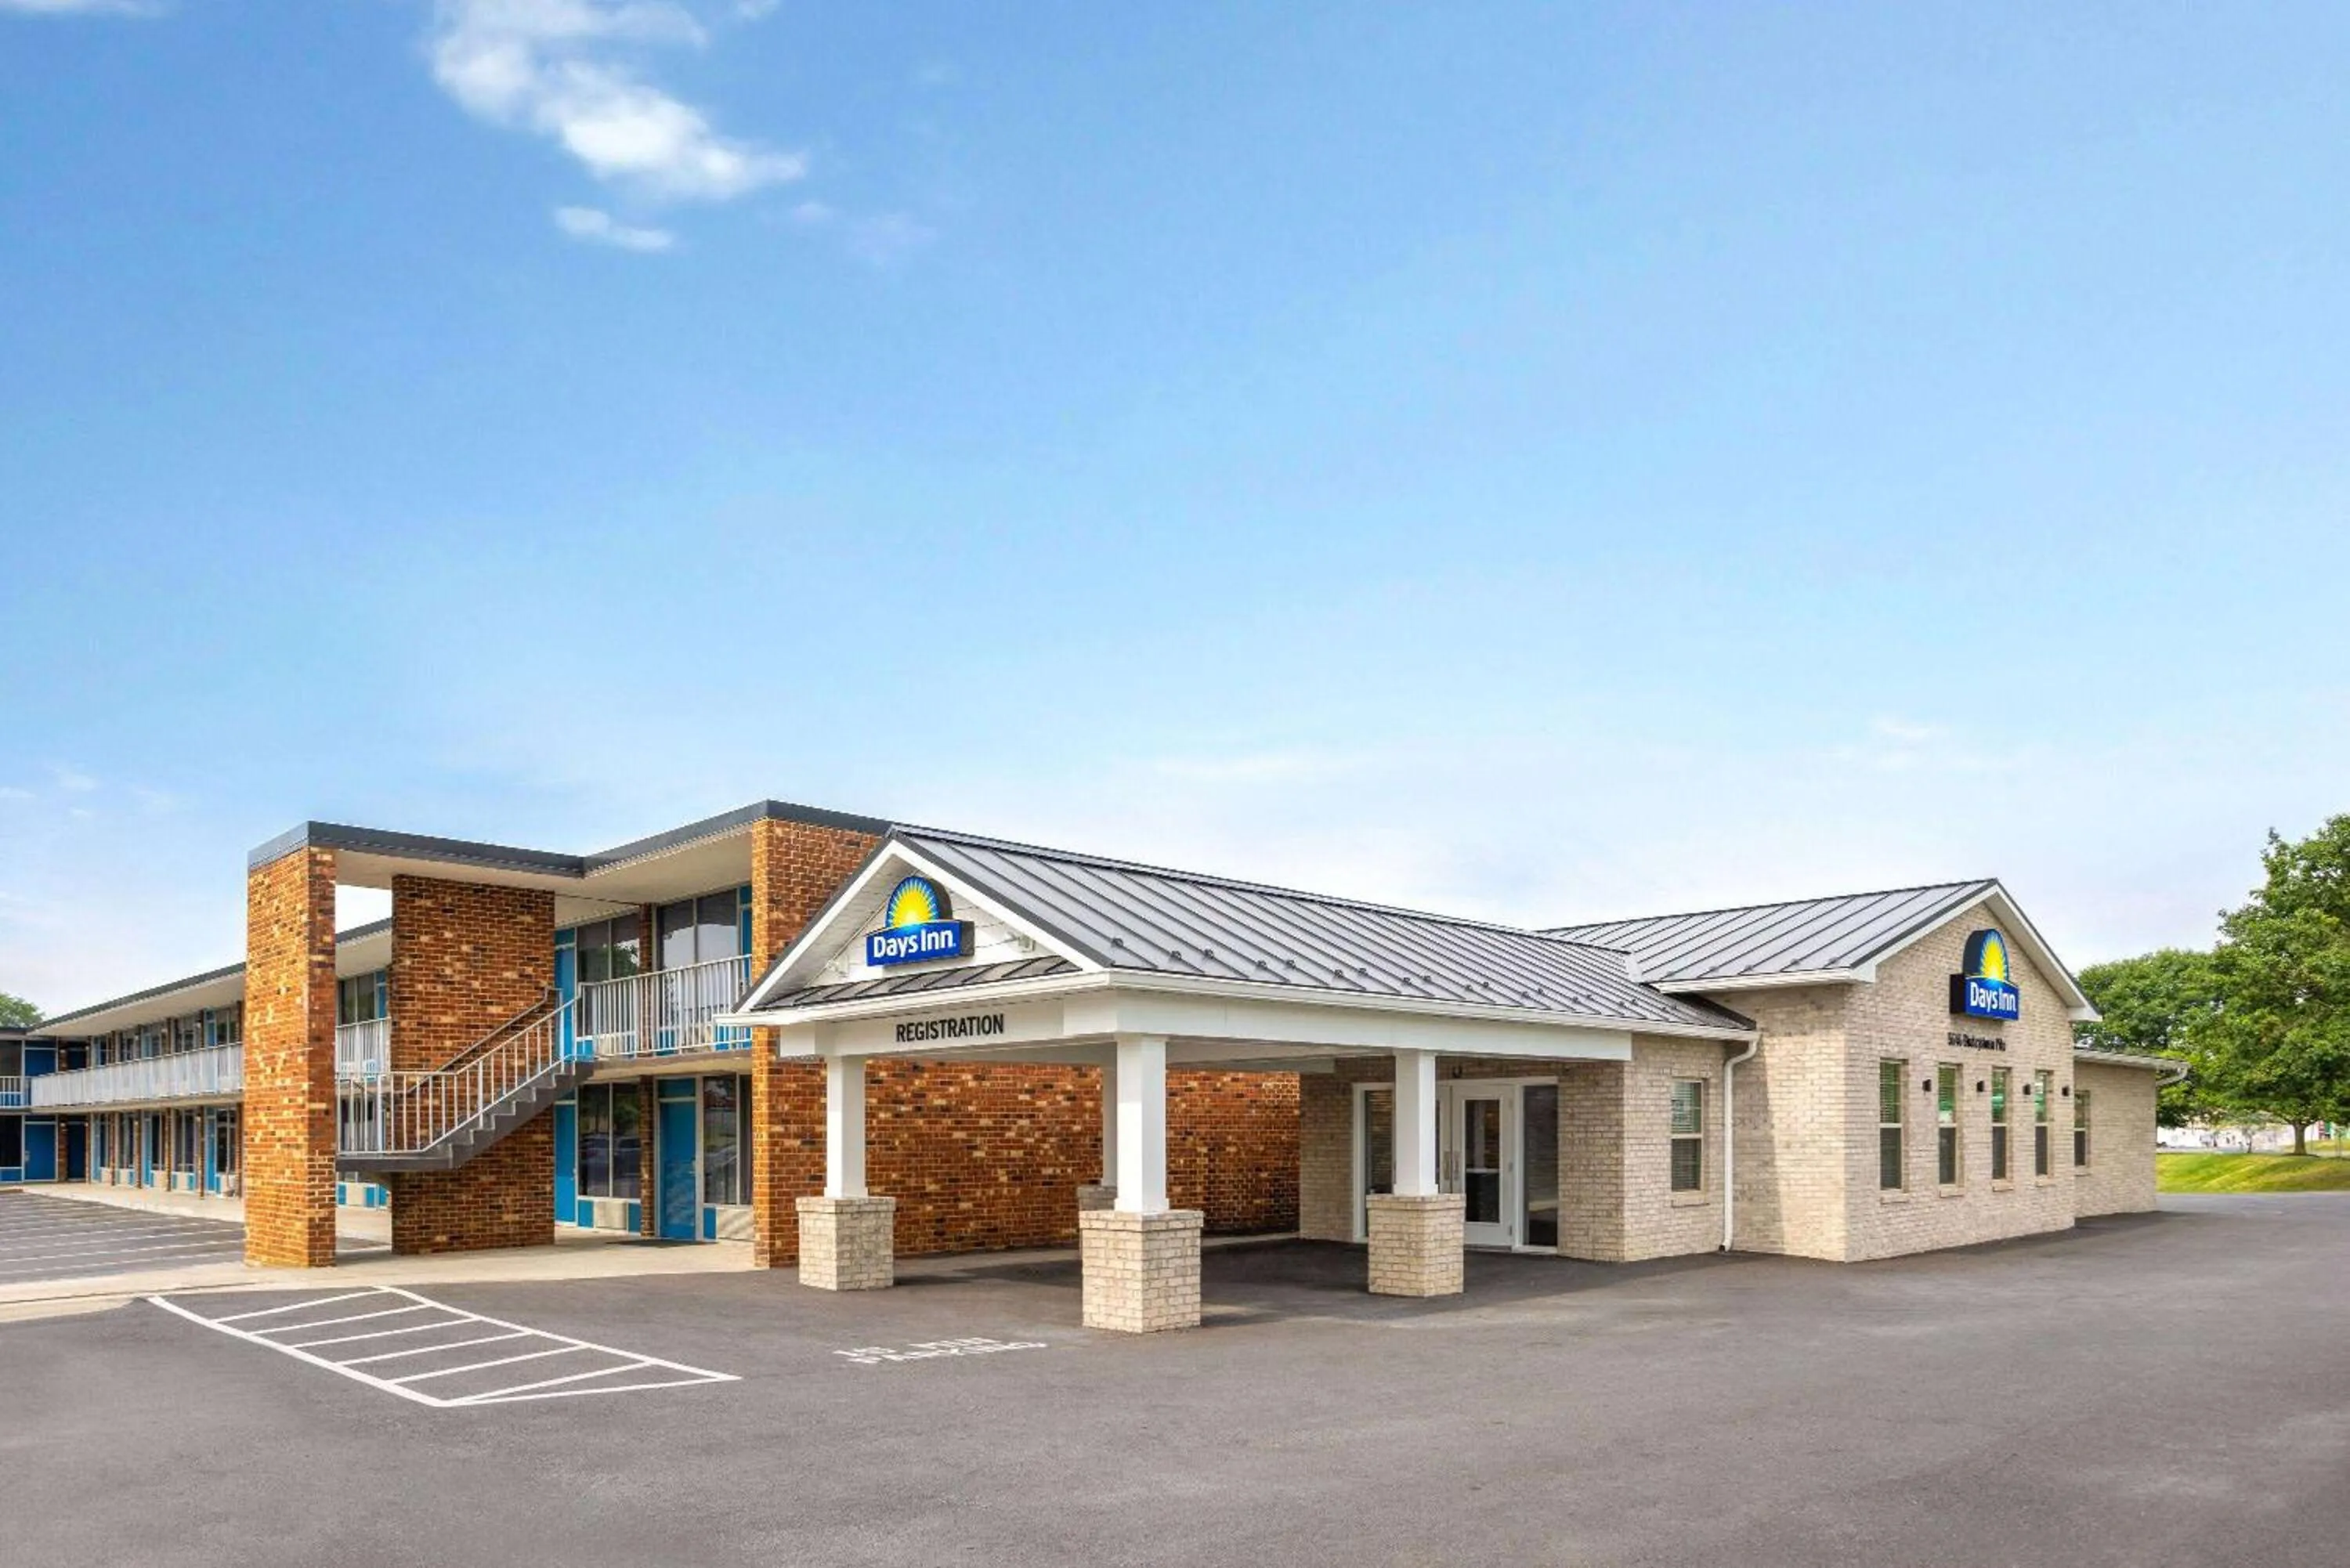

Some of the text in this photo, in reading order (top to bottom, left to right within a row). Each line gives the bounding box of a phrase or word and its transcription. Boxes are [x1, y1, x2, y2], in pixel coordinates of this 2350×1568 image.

[873, 928, 953, 958] Days Inn
[1970, 981, 2016, 1013] Days Inn
[895, 1013, 1004, 1042] REGISTRATION
